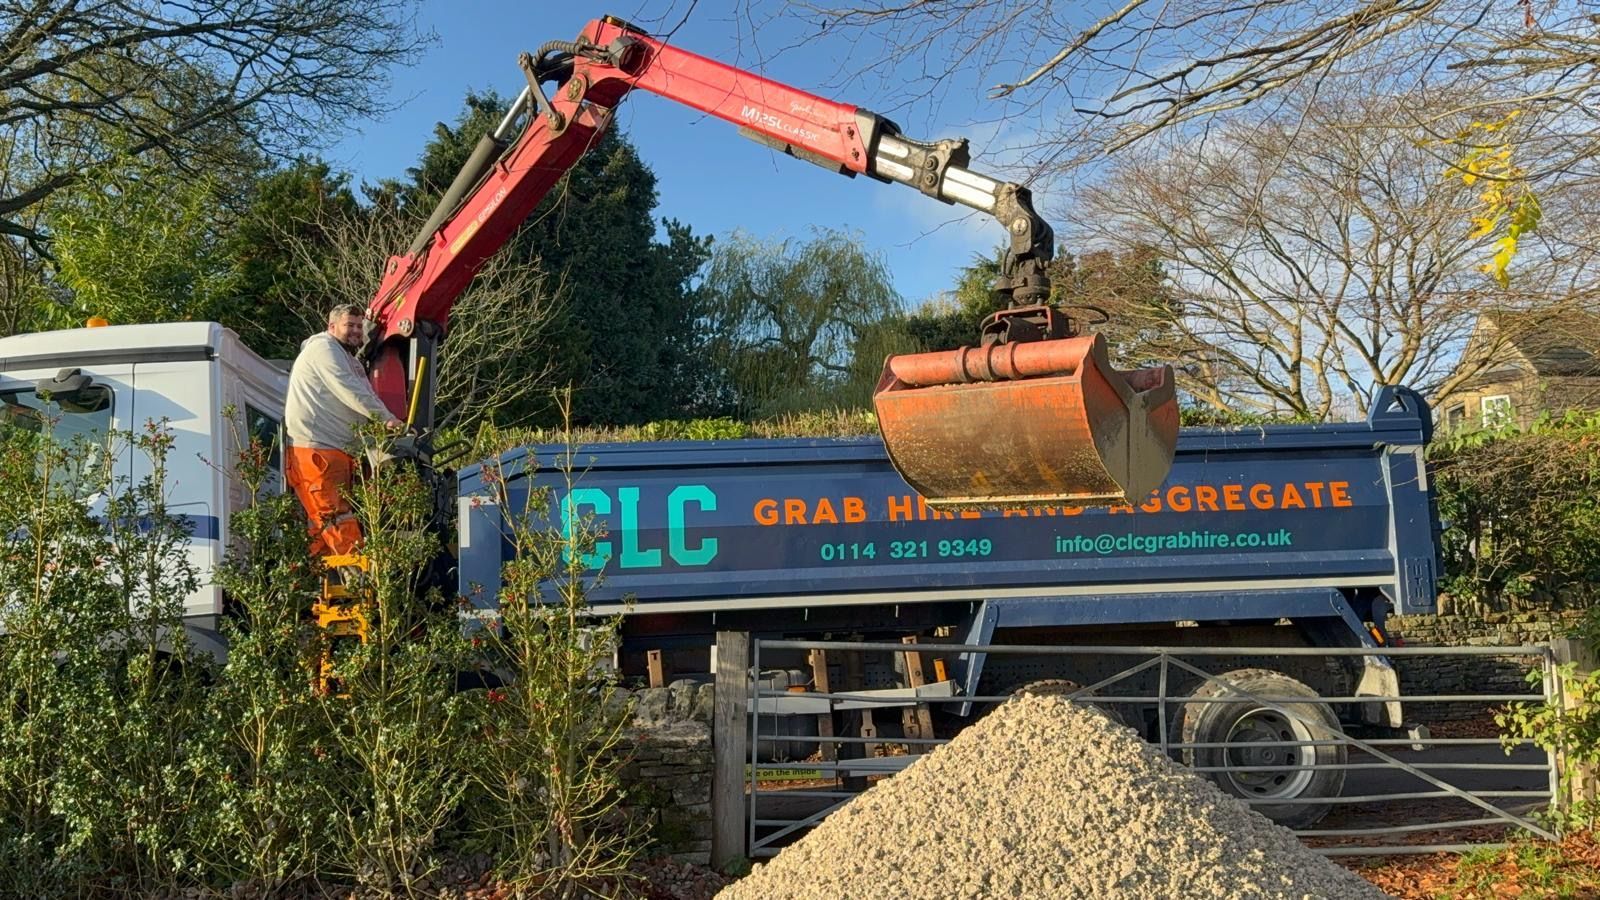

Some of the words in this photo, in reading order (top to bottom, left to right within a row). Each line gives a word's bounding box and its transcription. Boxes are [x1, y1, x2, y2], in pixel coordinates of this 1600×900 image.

[753, 497, 866, 526] GRAB
[888, 495, 982, 521] HI
[561, 485, 718, 569] CLC
[820, 543, 876, 560] 0114
[890, 541, 928, 558] 321
[938, 539, 992, 557] 9349
[1056, 529, 1292, 554] info@clcgrabhire.co.uk
